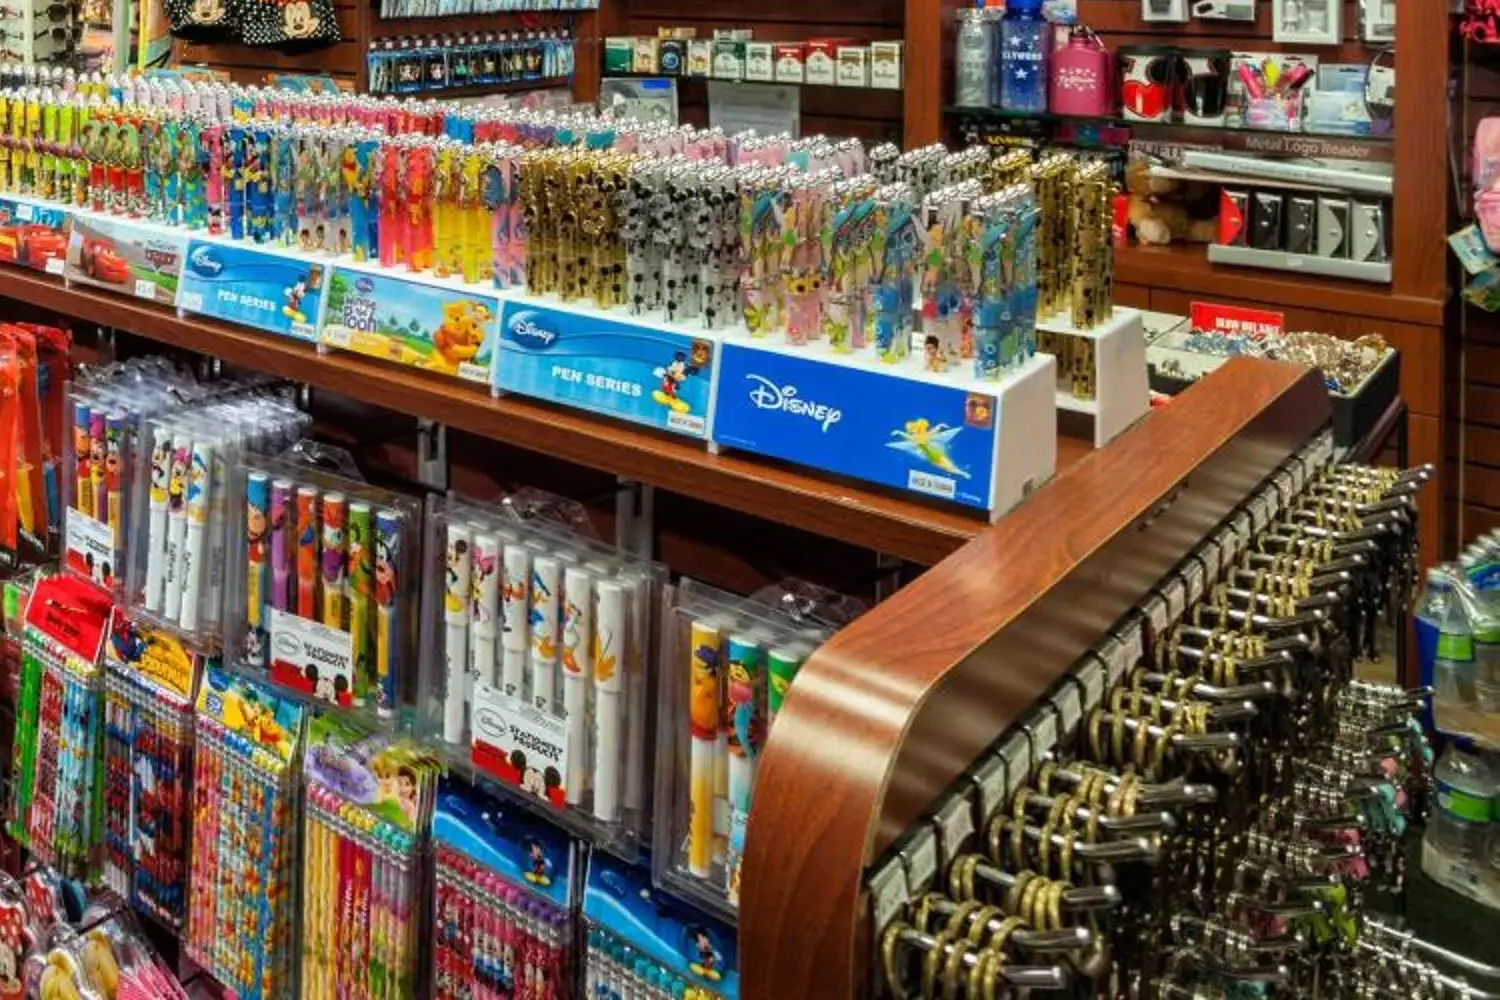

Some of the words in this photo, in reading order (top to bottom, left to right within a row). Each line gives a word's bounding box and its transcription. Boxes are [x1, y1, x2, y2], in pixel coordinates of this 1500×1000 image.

[239, 294, 277, 312] SERIES
[512, 320, 556, 344] Disney
[551, 365, 582, 382] PEN
[585, 371, 643, 398] SERIES
